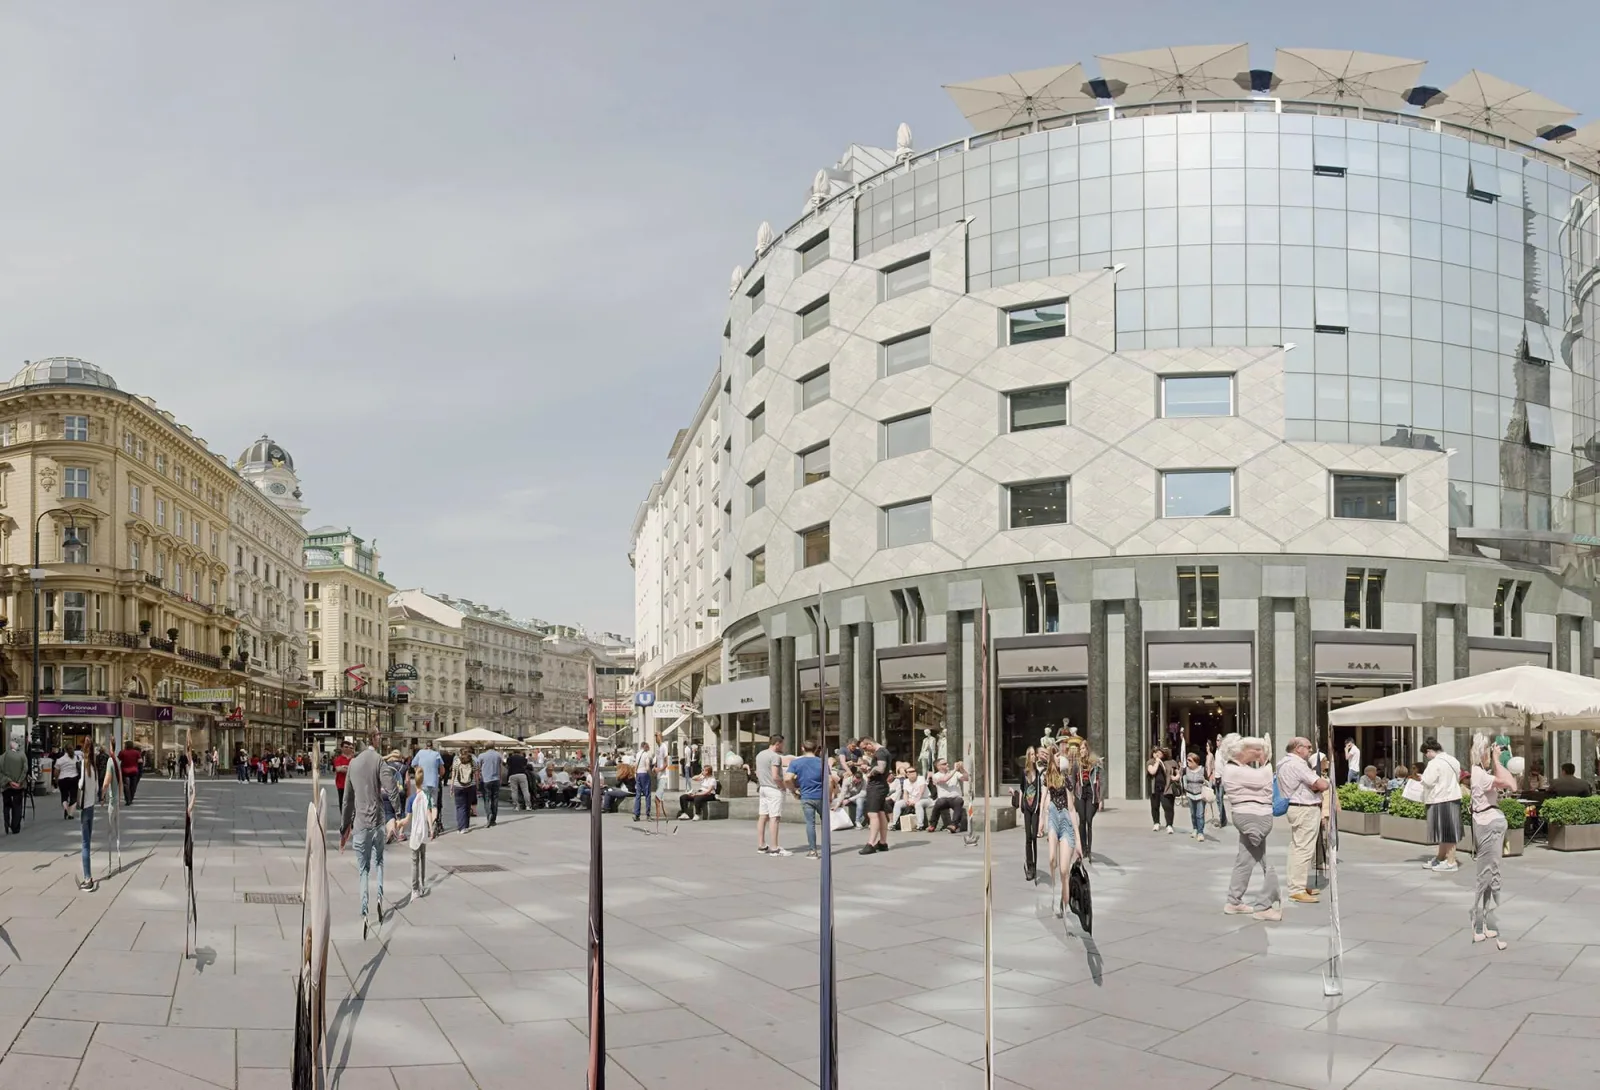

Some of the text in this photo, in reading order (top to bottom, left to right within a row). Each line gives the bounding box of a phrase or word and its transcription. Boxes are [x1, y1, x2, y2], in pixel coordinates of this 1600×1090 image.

[1027, 665, 1058, 673] ZARA
[1183, 661, 1217, 669] ZARA
[1347, 662, 1381, 670] ZARA
[902, 672, 926, 680] ZARA
[638, 693, 652, 705] U
[61, 703, 97, 711] Marionnaud
